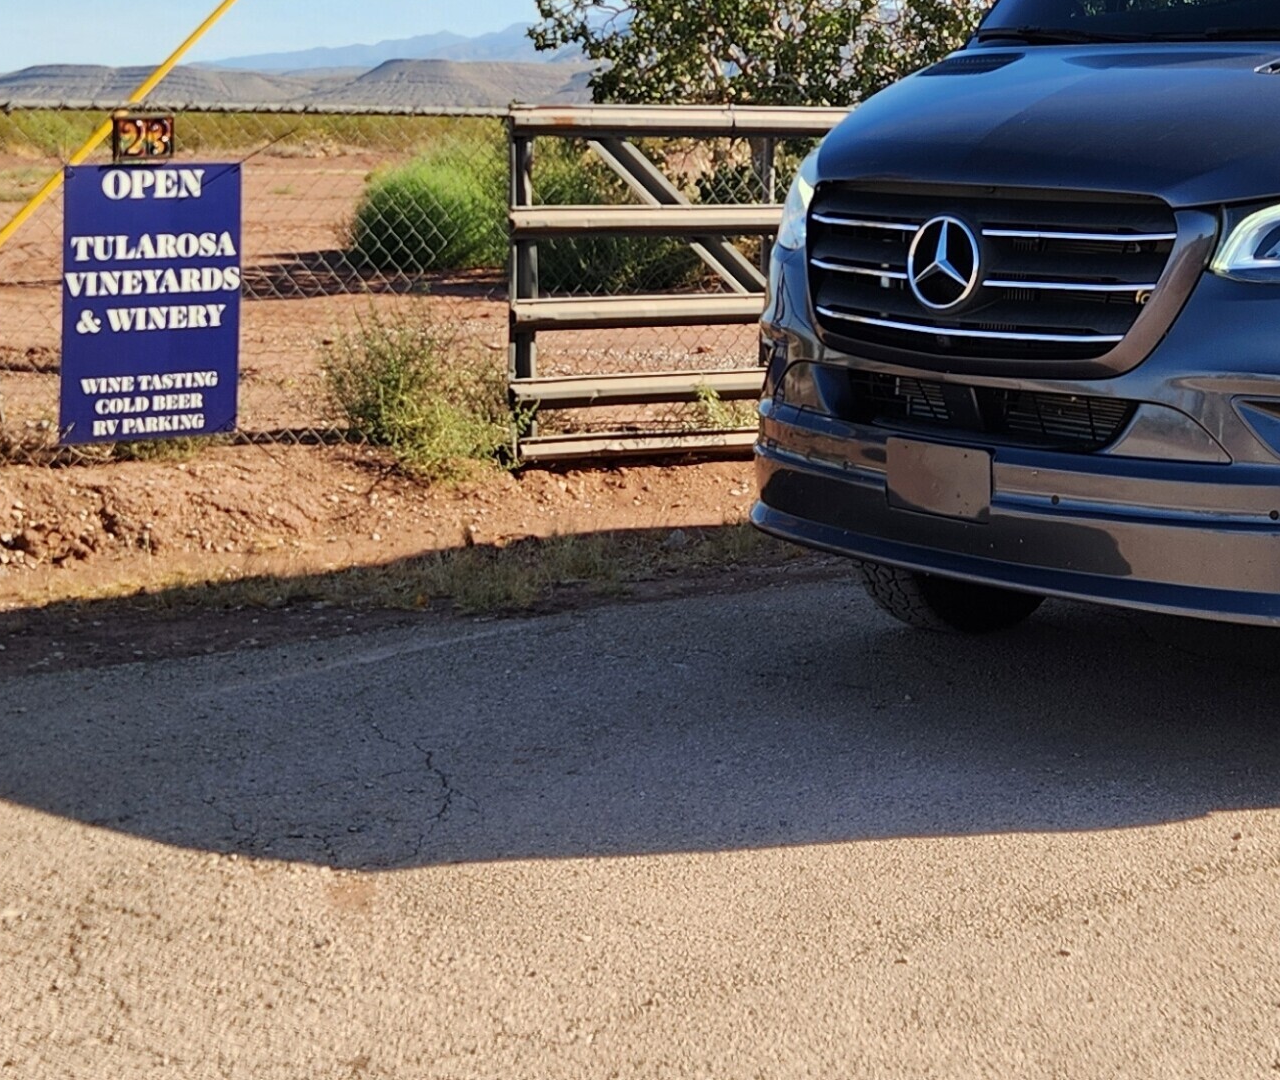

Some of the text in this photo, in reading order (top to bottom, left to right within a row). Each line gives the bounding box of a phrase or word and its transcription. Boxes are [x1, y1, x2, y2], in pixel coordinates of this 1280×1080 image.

[102, 169, 205, 200] OPEN
[71, 231, 237, 262] TULAROSA
[64, 267, 241, 298] VINEYARDS
[75, 304, 227, 334] & WINERY
[80, 370, 219, 395] WINE TASTING
[94, 392, 204, 415] COLD BEER
[92, 413, 206, 437] RV PARKING
